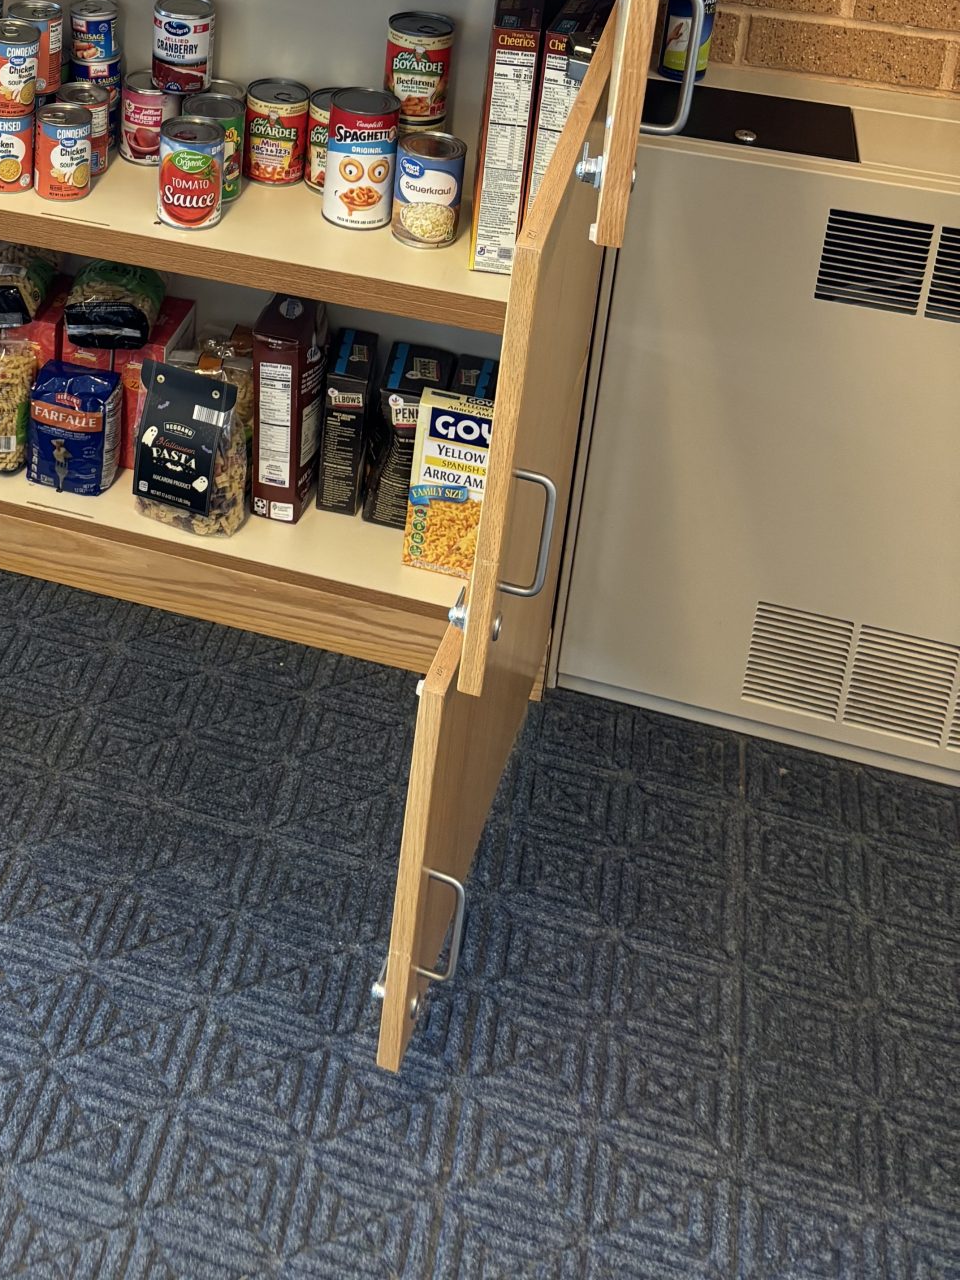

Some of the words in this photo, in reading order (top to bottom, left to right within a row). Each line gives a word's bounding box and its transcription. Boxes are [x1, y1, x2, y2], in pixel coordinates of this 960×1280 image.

[76, 32, 104, 40] SAUSAGE
[499, 34, 536, 48] Cheerios
[6, 44, 39, 57] CONDENSED
[157, 39, 198, 54] CRANBERRY
[9, 65, 34, 74] Chicken
[393, 57, 443, 73] BOYARDEE
[396, 76, 435, 88] Beefaroni
[57, 127, 90, 138] CONDENSED
[250, 123, 297, 139] BOYARDEE
[261, 140, 280, 148] Mini
[60, 147, 86, 156] Chicken
[176, 157, 205, 169] Organic
[172, 177, 209, 190] TOMATO
[405, 181, 451, 196] Sauerkraut
[164, 184, 215, 208] Sauce
[334, 395, 361, 404] ELBOWS
[469, 398, 494, 407] GOY
[35, 406, 97, 428] FARFALLE
[395, 407, 419, 420] PENN
[166, 423, 193, 436] REGGANO
[435, 415, 493, 444] GOY
[156, 437, 196, 455] Halloween
[151, 447, 196, 470] PASTA
[437, 444, 485, 464] YELLOW
[441, 460, 480, 474] SPANISH
[152, 474, 173, 485] MACARONI
[173, 478, 191, 490] PRODUCT
[423, 466, 461, 485] ARROZ
[412, 488, 444, 498] FAMILY
[445, 489, 464, 499] SIZE
